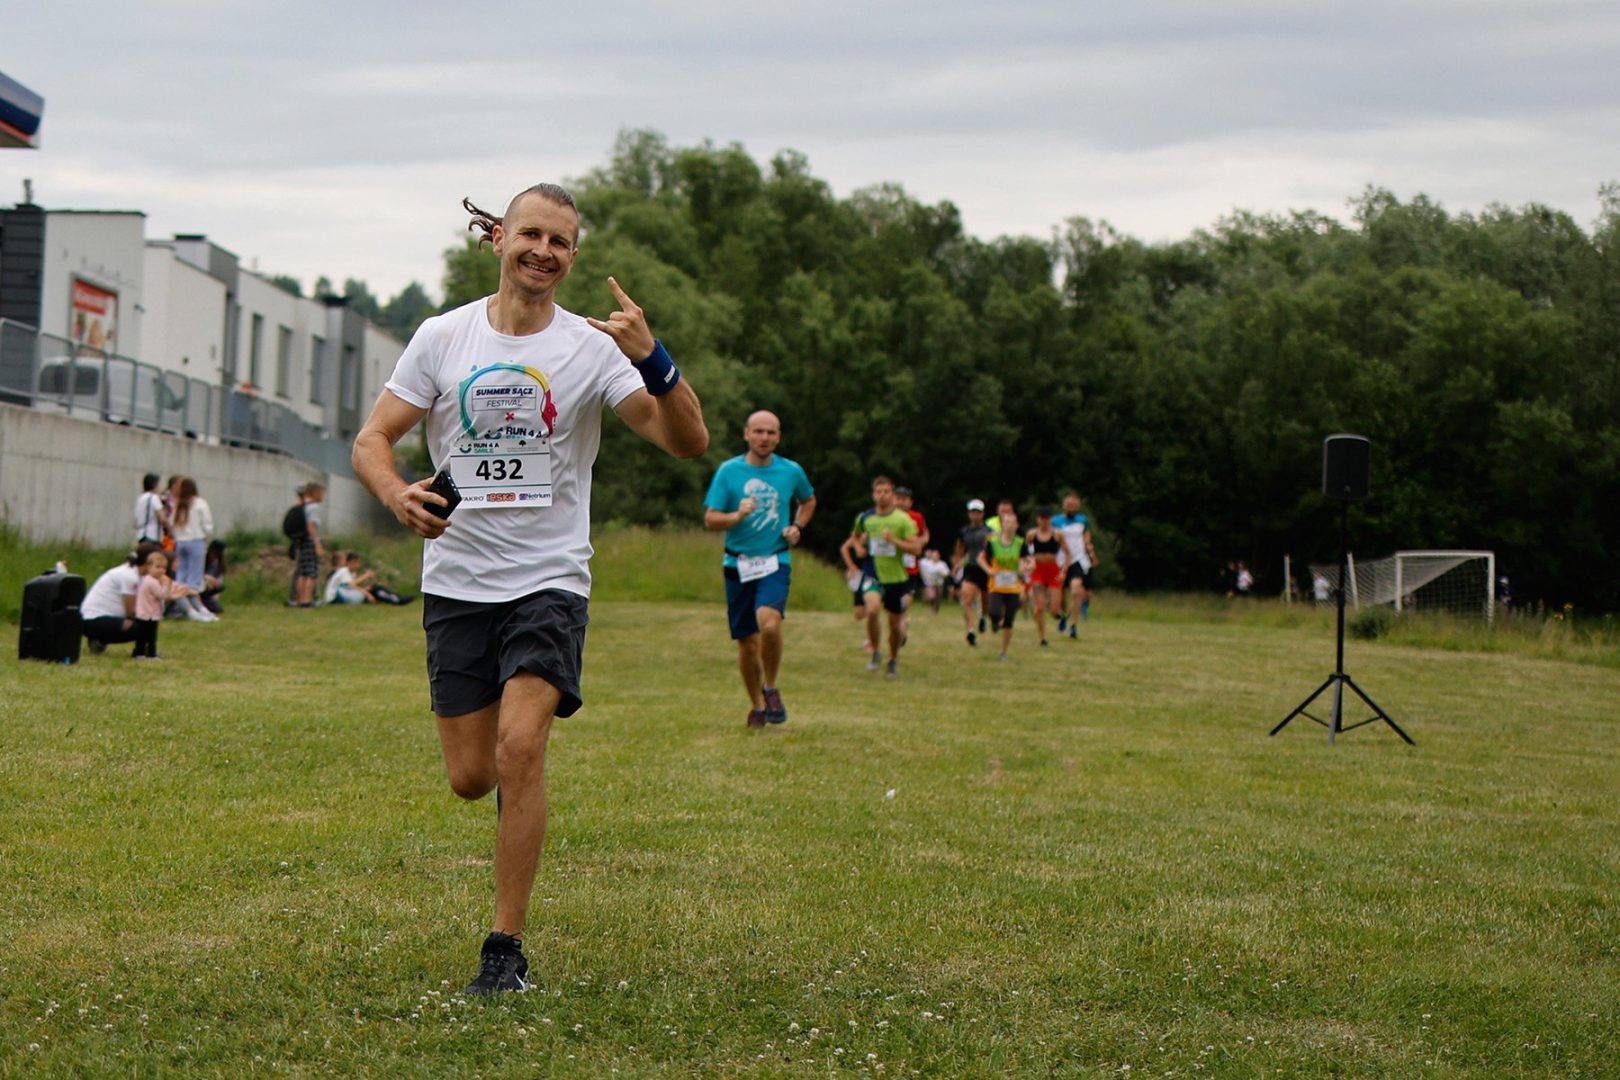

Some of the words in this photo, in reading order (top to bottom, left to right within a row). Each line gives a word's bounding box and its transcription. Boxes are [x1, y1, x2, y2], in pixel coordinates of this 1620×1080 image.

[476, 388, 510, 396] SUMMER
[512, 388, 533, 396] SĄCZ
[487, 399, 522, 407] FESTIVAL
[506, 427, 526, 436] RUN
[476, 459, 523, 480] 432
